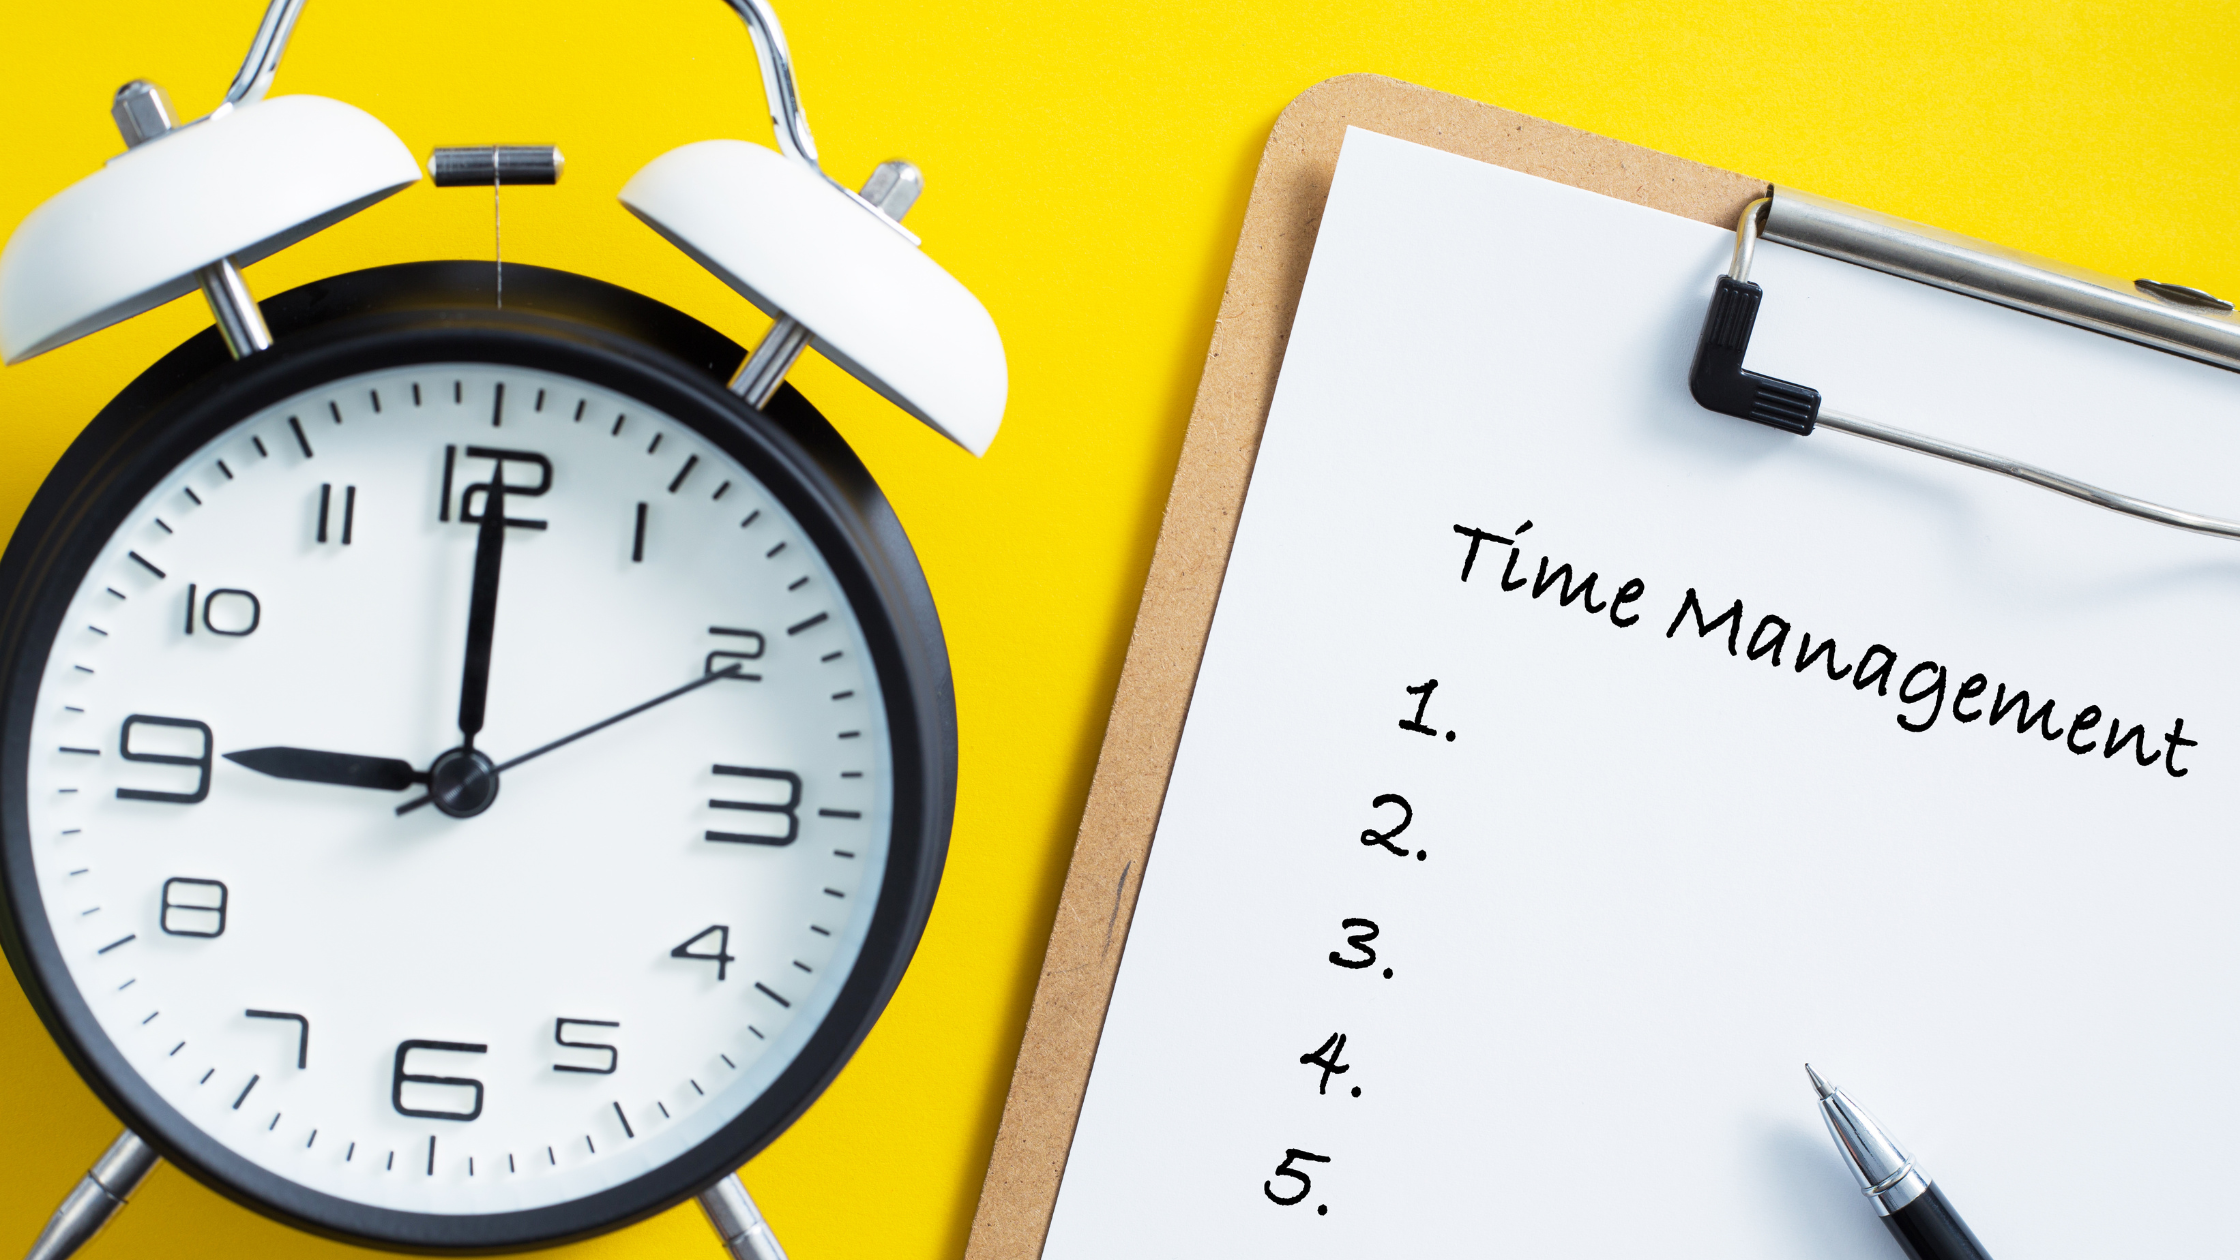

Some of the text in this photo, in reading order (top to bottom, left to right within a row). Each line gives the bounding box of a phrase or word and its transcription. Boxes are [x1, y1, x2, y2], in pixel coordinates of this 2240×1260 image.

[316, 483, 357, 545] 11
[438, 444, 554, 532] 12
[184, 583, 261, 637] 10
[705, 626, 767, 682] 2
[1453, 519, 2199, 778] Time Management
[1398, 678, 1458, 744] 1.
[115, 714, 214, 804] 9
[704, 764, 803, 847] 3
[1360, 793, 1428, 862] 2.
[160, 876, 228, 939] 8
[671, 925, 735, 981] 4
[1328, 917, 1394, 981] 3.
[244, 1008, 309, 1070] 7
[553, 1017, 620, 1075] 5
[1299, 1031, 1363, 1099] 4.
[391, 1039, 489, 1122] 6
[1263, 1147, 1332, 1217] 5.
